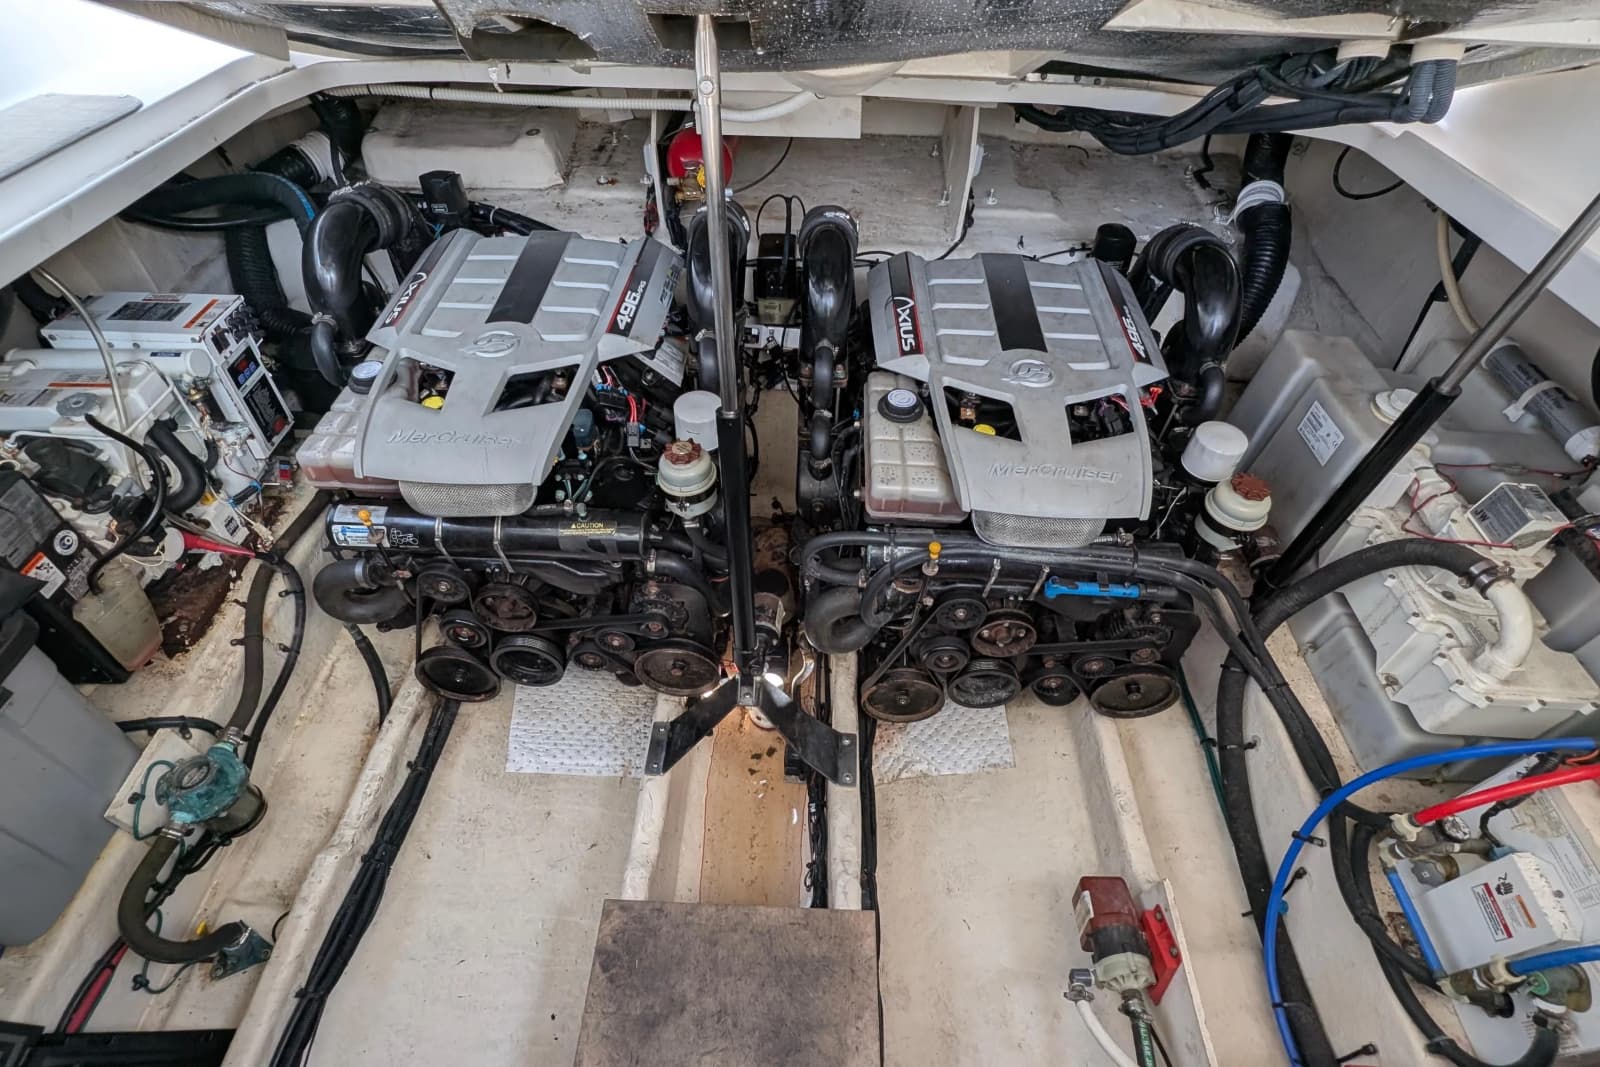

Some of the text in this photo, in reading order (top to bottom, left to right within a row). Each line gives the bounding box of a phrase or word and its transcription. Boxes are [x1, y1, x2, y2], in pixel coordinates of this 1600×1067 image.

[616, 290, 641, 330] 496
[893, 296, 916, 352] AXIUS
[1122, 316, 1146, 358] 496
